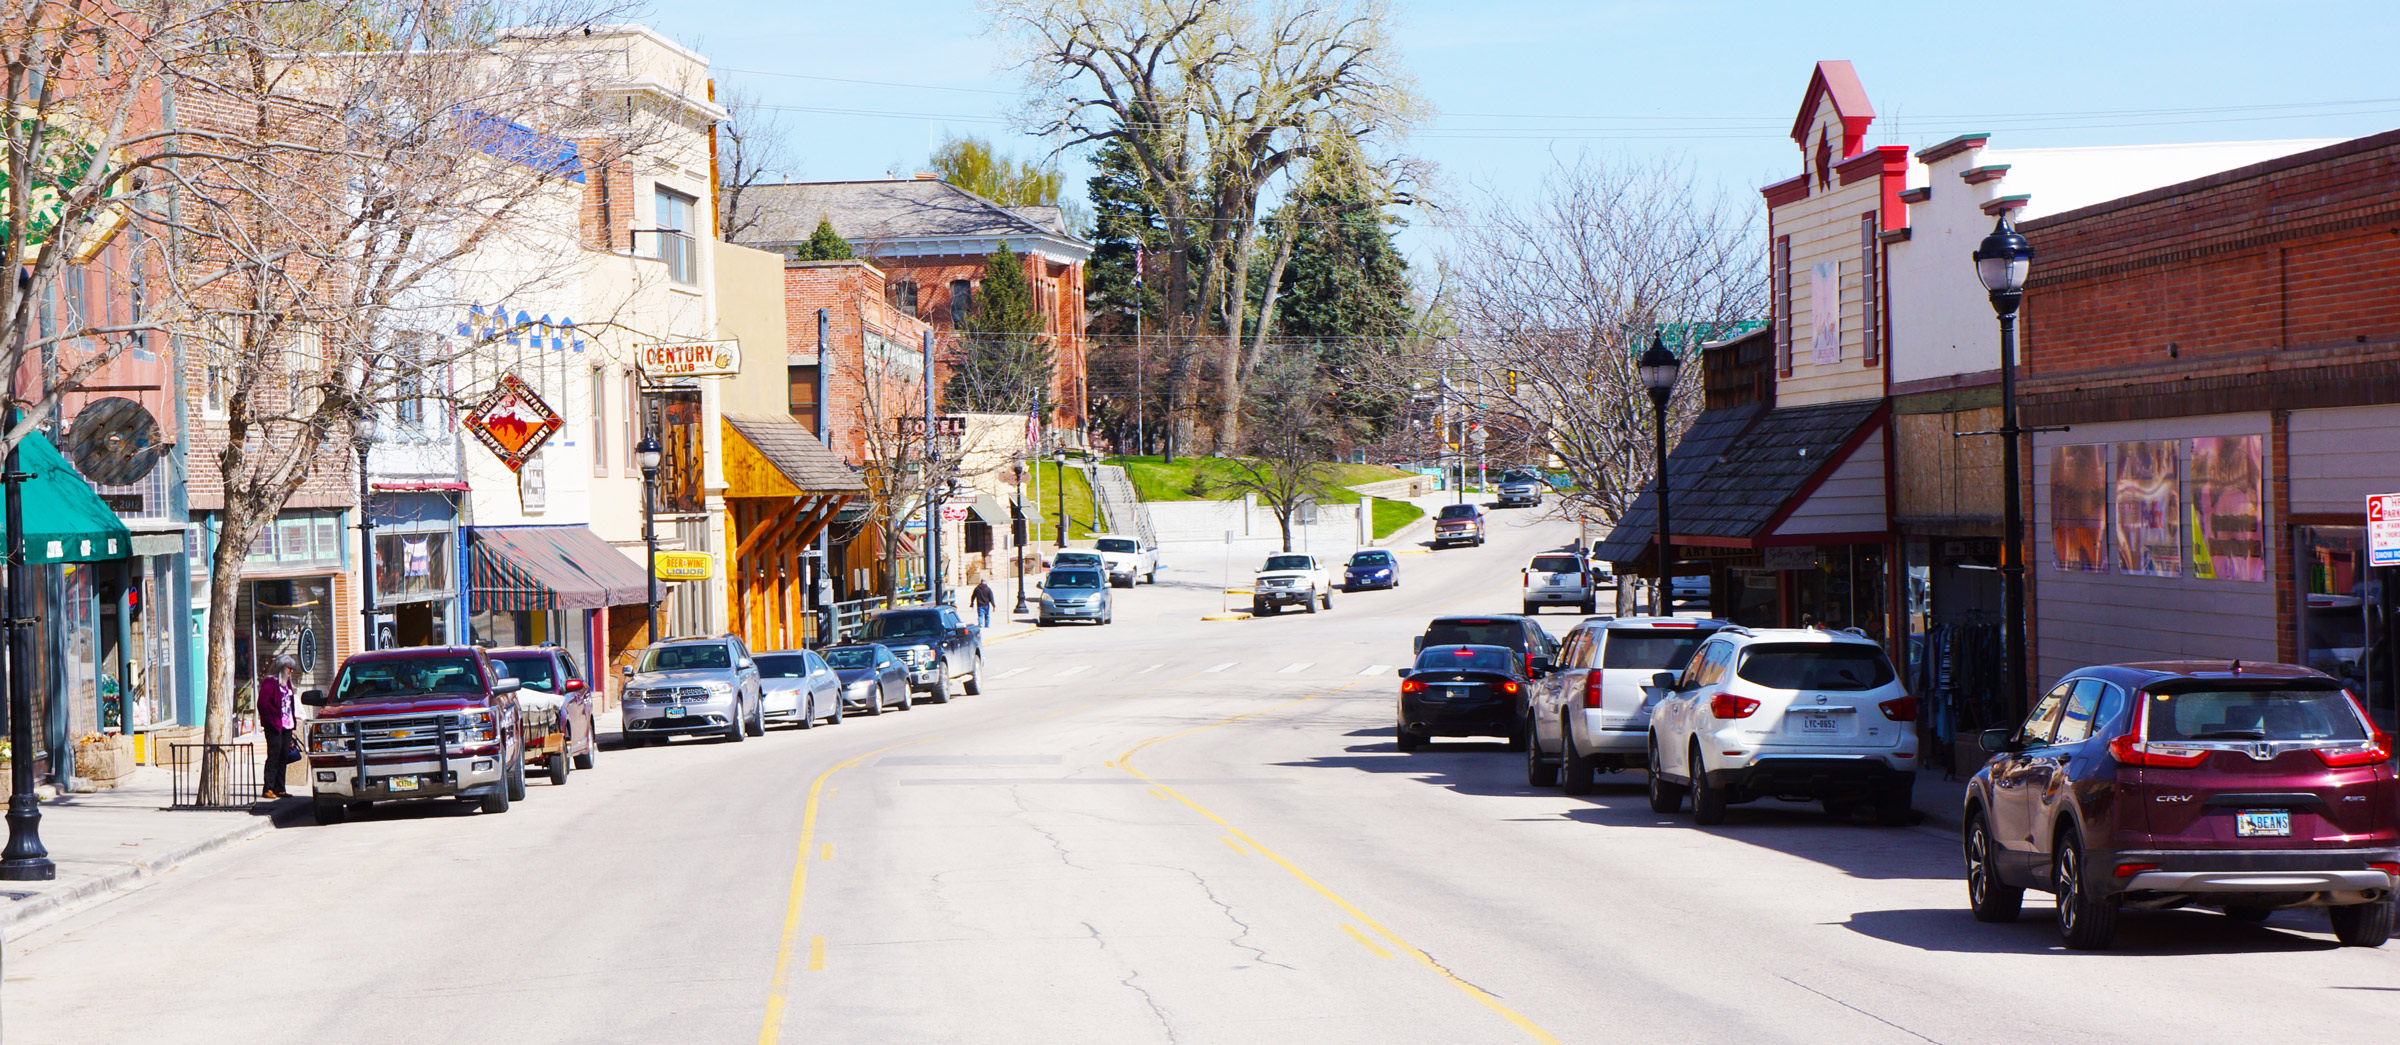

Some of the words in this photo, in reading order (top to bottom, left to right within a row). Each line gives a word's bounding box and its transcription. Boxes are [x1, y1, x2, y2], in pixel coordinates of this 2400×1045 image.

[647, 345, 713, 365] CENTURY
[666, 363, 695, 373] CLUB
[516, 385, 549, 416] BUFFALO
[901, 420, 963, 434] OEL
[479, 429, 506, 454] SUPPLY
[518, 425, 549, 458] COMPANY
[119, 500, 140, 509] 2012
[2371, 500, 2382, 518] 2
[1685, 546, 1707, 557] ART
[667, 558, 683, 568] BEER
[688, 558, 704, 568] WINE
[2156, 794, 2193, 802] CR-V
[2257, 816, 2288, 829] BEANS
